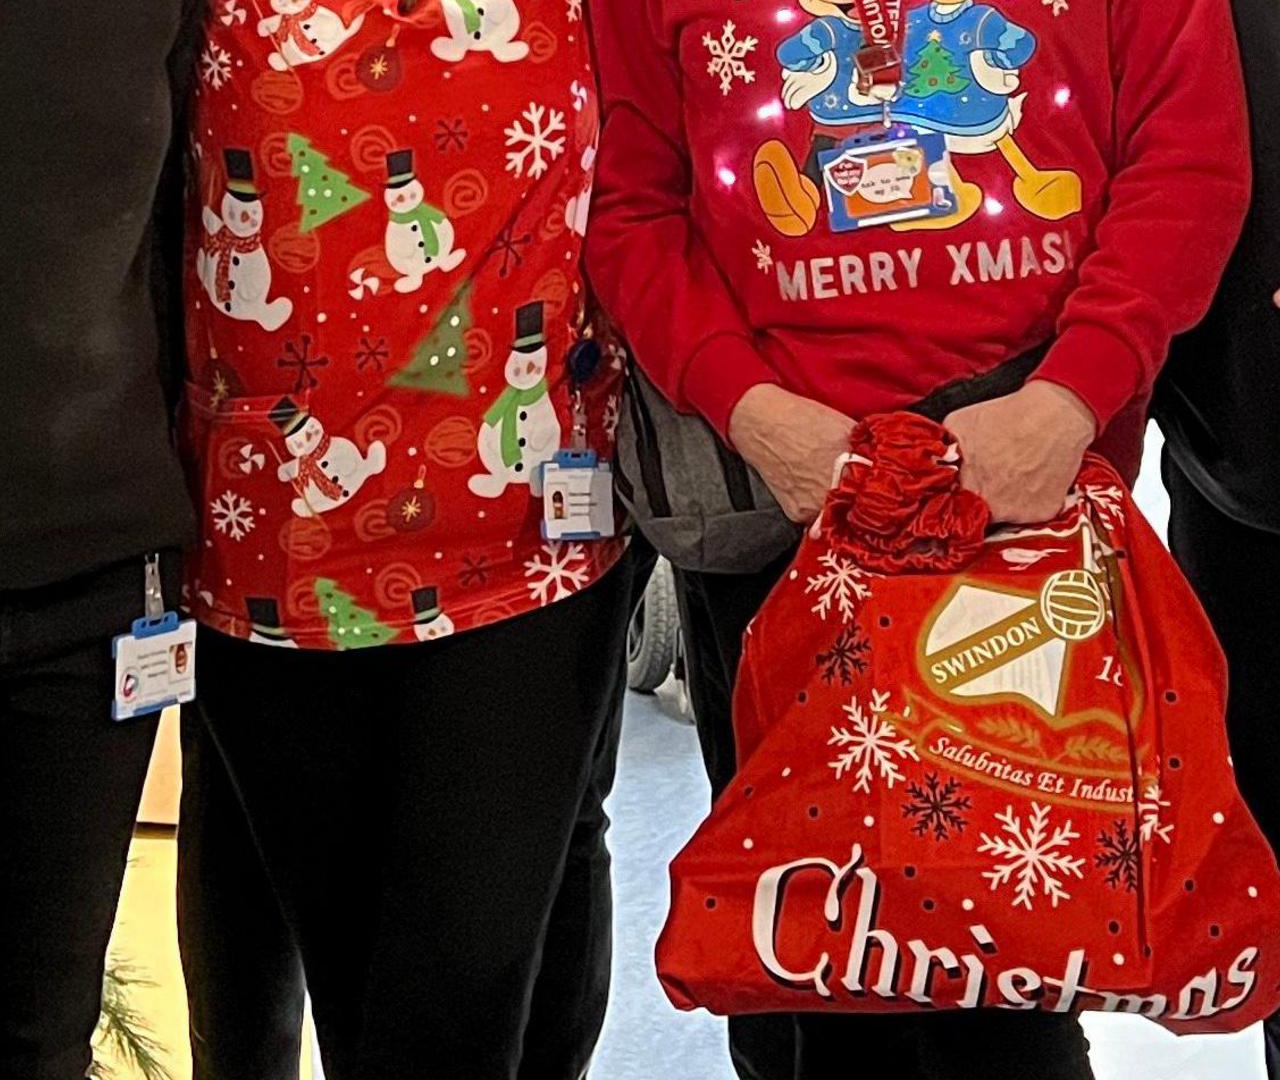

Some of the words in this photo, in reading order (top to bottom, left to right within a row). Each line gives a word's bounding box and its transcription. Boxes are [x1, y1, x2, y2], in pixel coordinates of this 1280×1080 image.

[775, 247, 924, 301] MERRY
[929, 615, 1043, 685] SWINDON
[928, 736, 1035, 788] Salubritas
[1036, 771, 1066, 794] Et
[752, 843, 1259, 1020] Christmas
